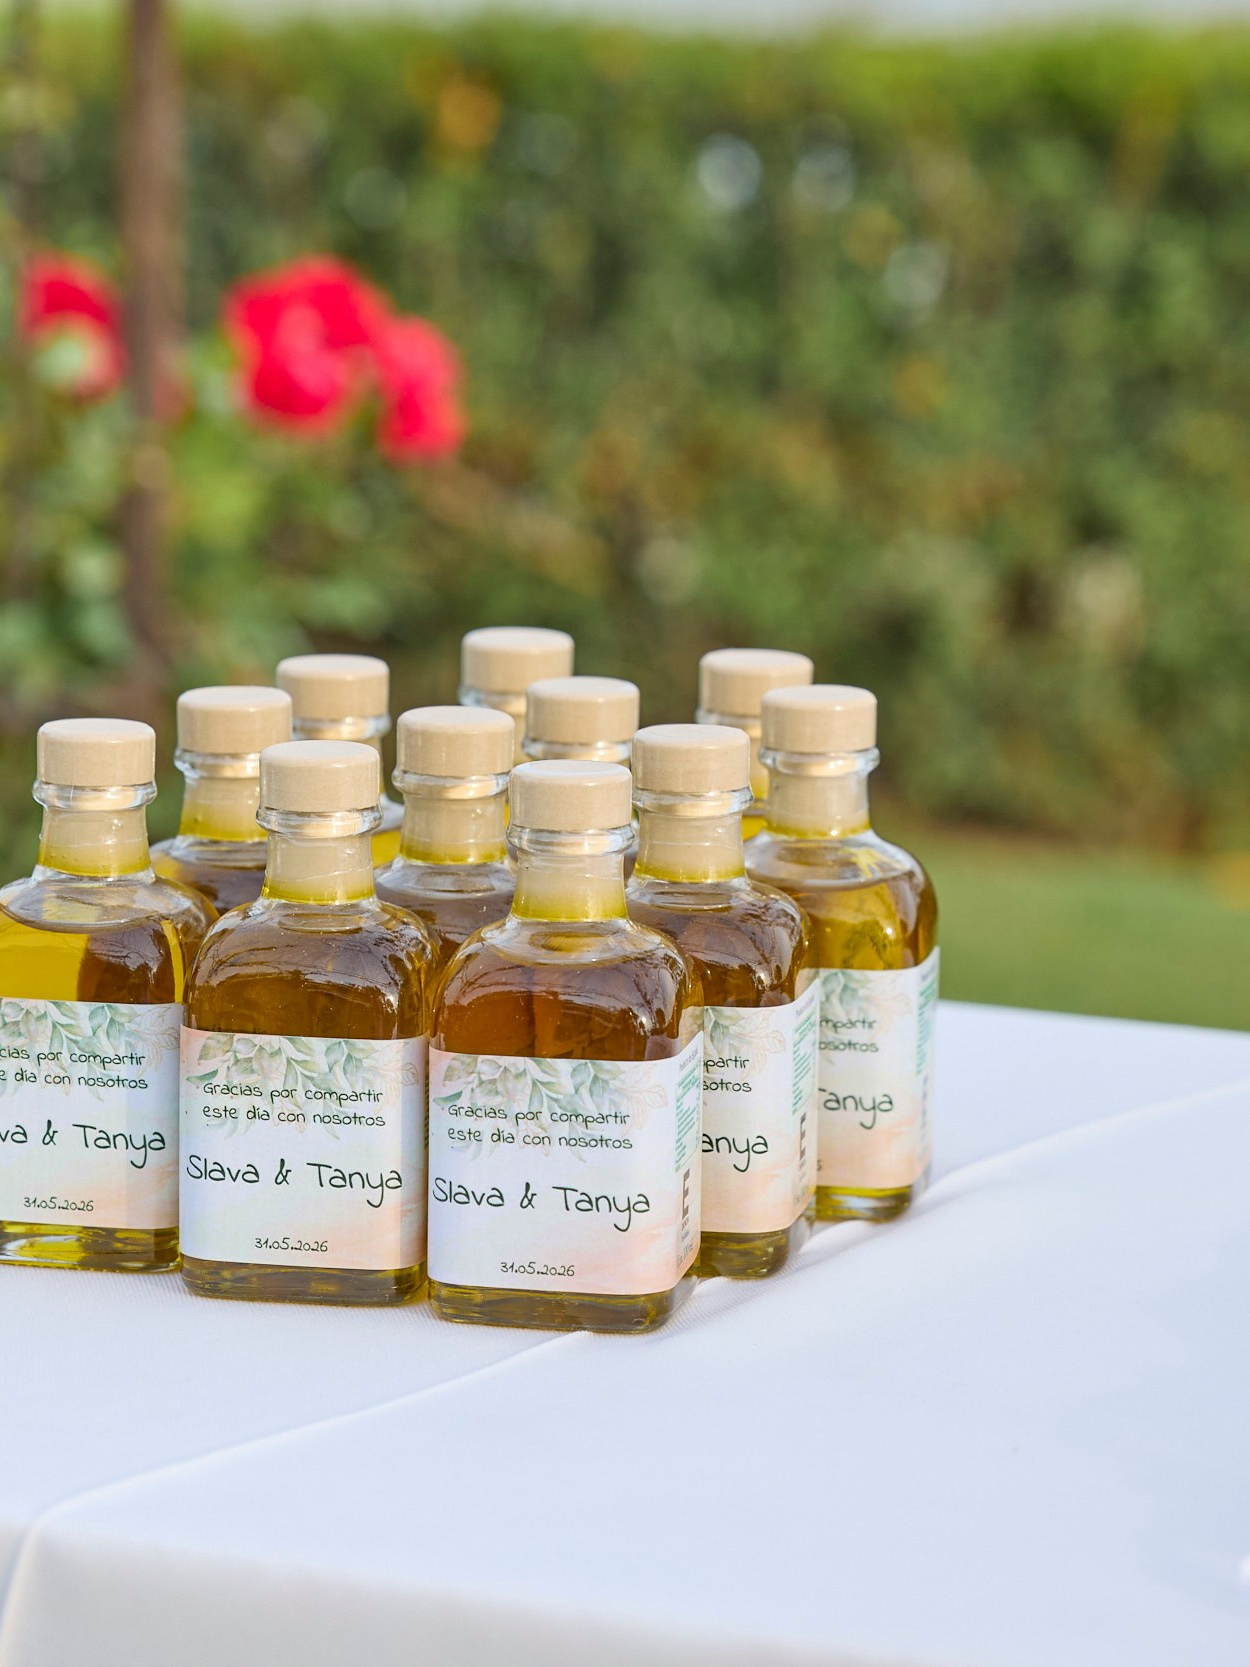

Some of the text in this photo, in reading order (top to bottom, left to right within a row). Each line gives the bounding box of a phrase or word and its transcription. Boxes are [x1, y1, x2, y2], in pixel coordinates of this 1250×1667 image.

[820, 1017, 877, 1032] mpartir
[819, 1041, 879, 1052] osotros
[37, 1051, 62, 1066] por
[70, 1052, 146, 1070] compartir
[703, 1056, 749, 1072] partir
[15, 1067, 37, 1082] día
[44, 1074, 71, 1084] con
[78, 1075, 148, 1089] nosotros
[203, 1083, 383, 1107] Gracias por compartir
[203, 1105, 386, 1126] este día con nosotros
[448, 1105, 630, 1130] Gracias por compartir
[42, 1120, 58, 1145] &
[73, 1124, 166, 1169] Tanya
[448, 1128, 633, 1149] este día con nosotros
[702, 1134, 769, 1172] anya
[187, 1155, 403, 1208] Slava & Tanya
[24, 1197, 94, 1211] 31.05.2026
[432, 1178, 504, 1207] Slava
[520, 1182, 537, 1209] &
[552, 1186, 650, 1232] Tanya
[255, 1238, 328, 1252] 31.05.2026
[501, 1262, 575, 1277] 31.05.2026
